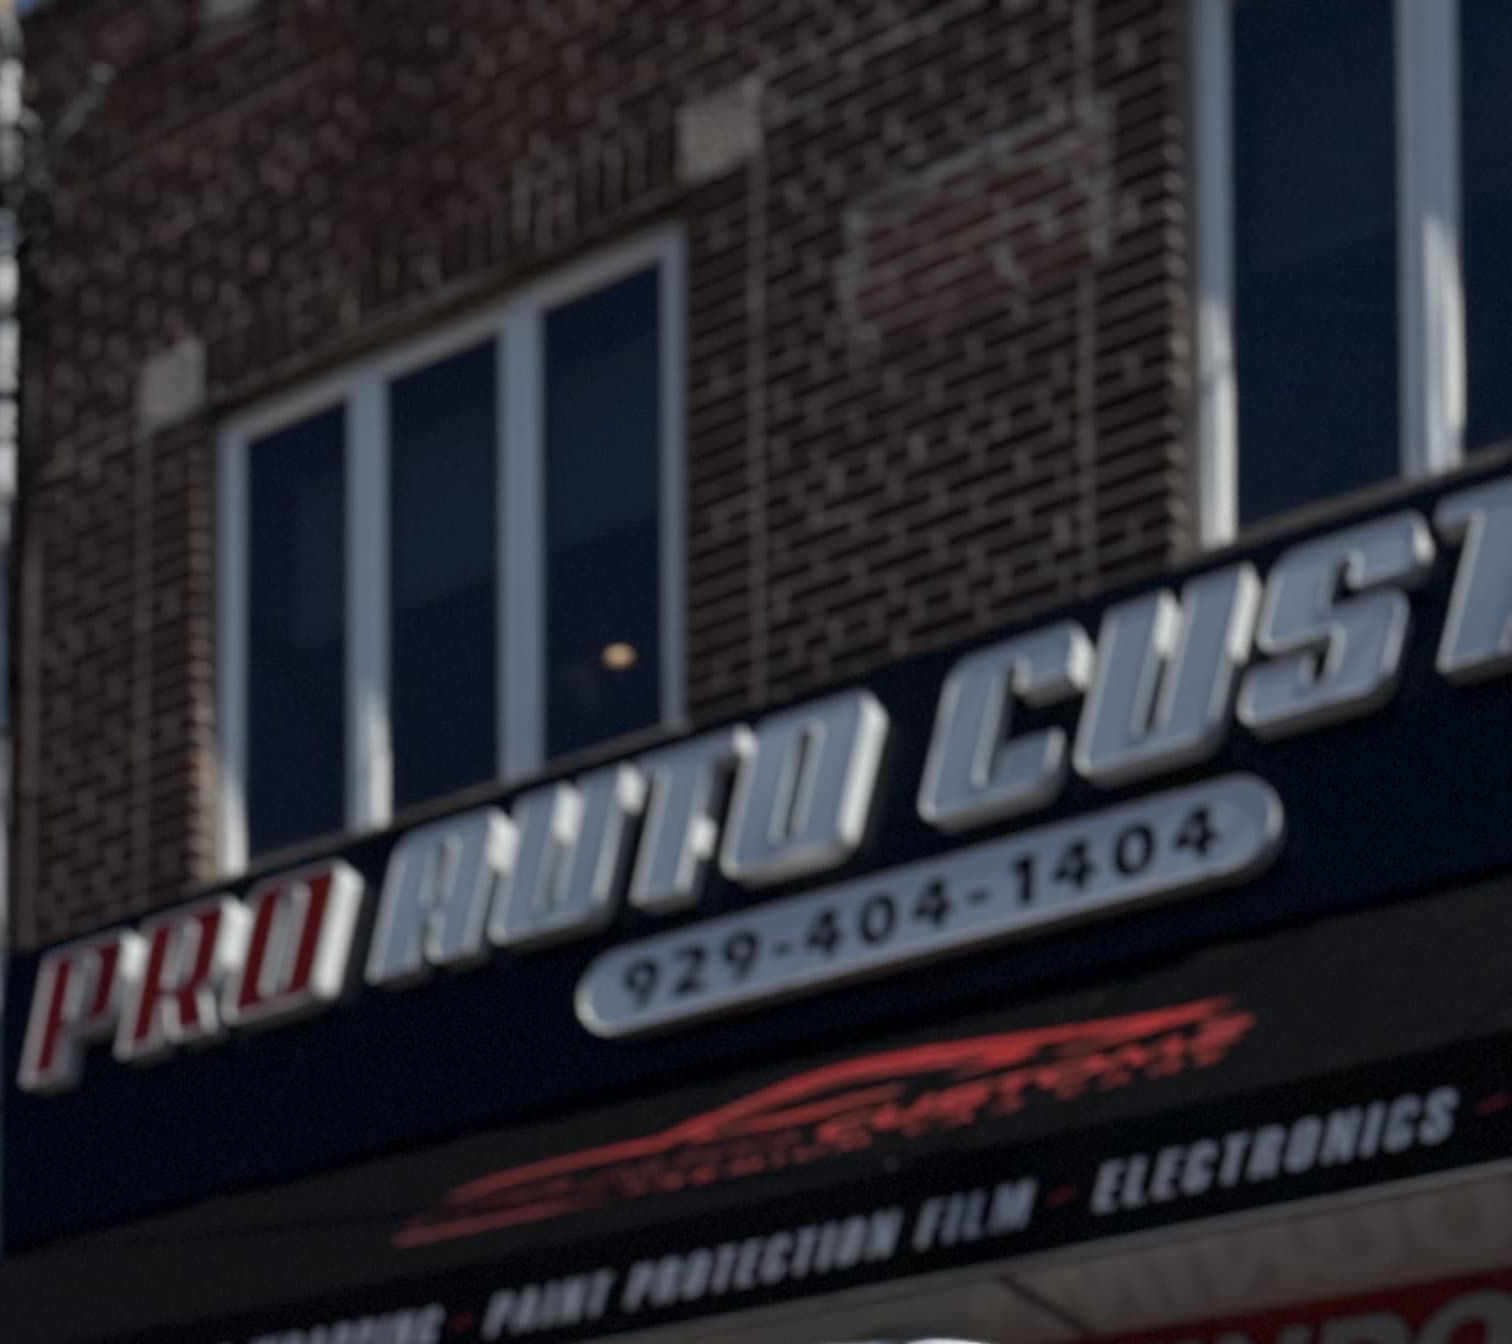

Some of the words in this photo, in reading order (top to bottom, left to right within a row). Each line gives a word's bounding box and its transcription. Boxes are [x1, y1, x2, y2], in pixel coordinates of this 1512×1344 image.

[17, 857, 365, 1092] PRO
[364, 688, 888, 986] AUTO
[622, 804, 1225, 1010] 929-404-1404
[481, 1267, 616, 1341] PAINT
[620, 1207, 903, 1313] PROTECTION
[912, 1177, 1038, 1254] FILM
[1091, 1086, 1461, 1216] ELECTRONICS
